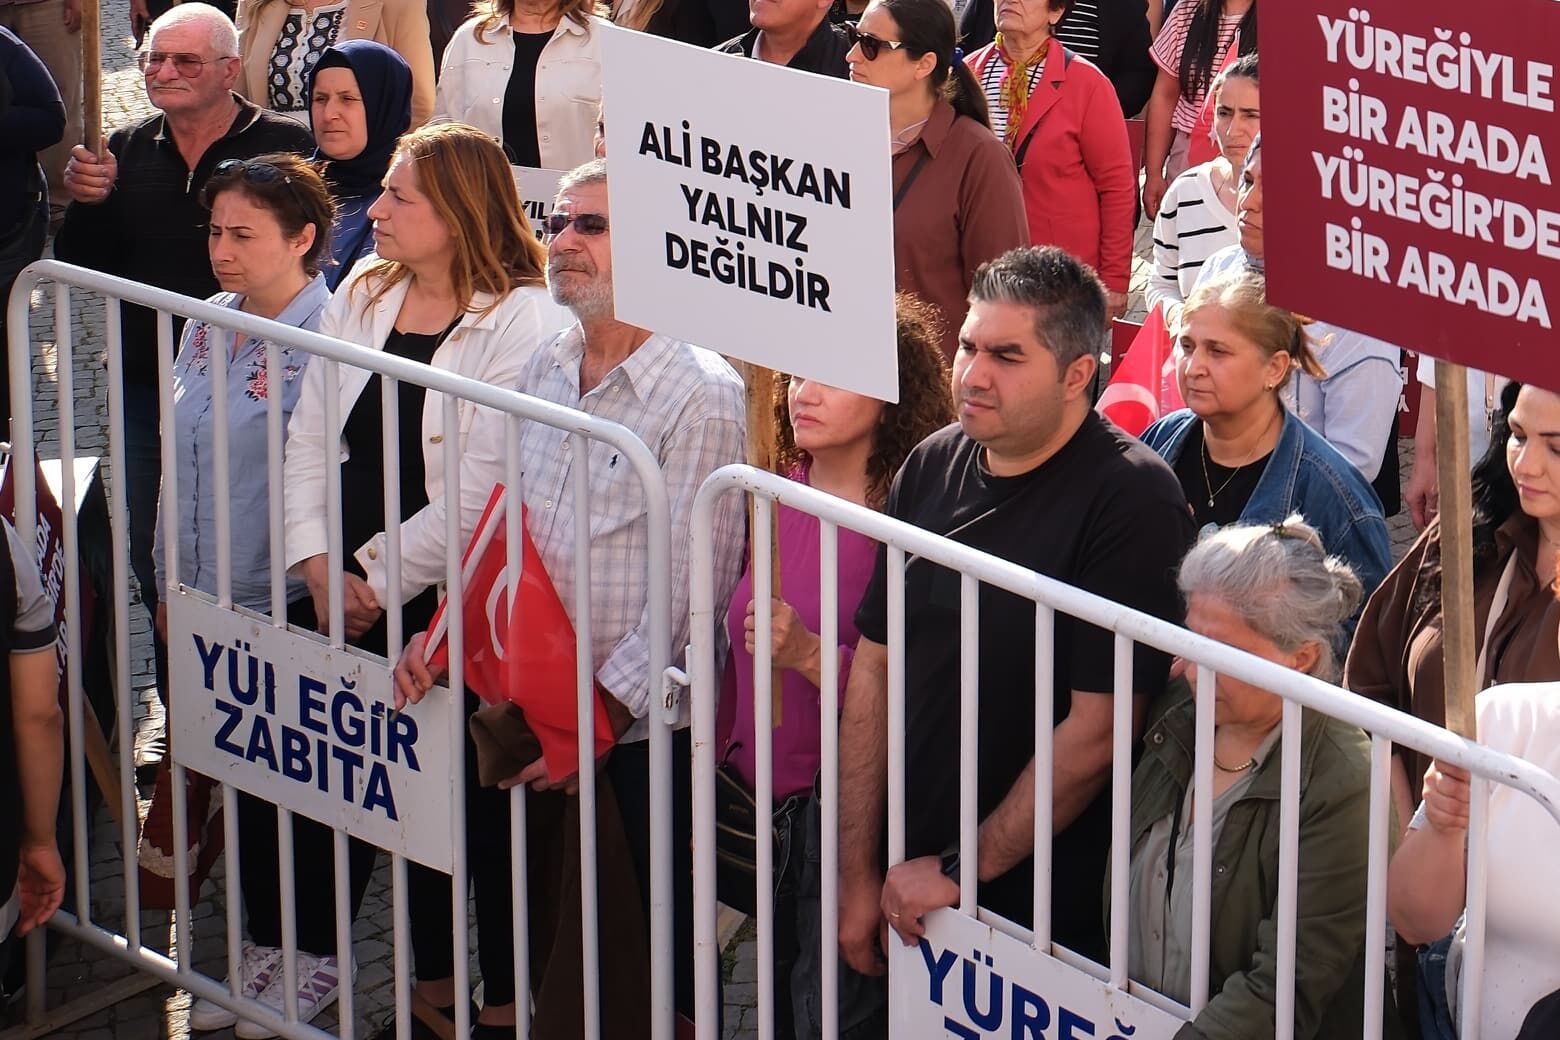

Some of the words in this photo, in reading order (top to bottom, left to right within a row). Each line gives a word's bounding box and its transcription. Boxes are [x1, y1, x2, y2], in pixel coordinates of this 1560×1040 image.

[1316, 7, 1555, 113] YÜREĞİYLE
[638, 119, 693, 169] ALİ
[701, 136, 851, 210] BAŞKAN
[1322, 78, 1389, 146] BİR
[1395, 105, 1552, 186] ARADA
[680, 183, 809, 253] YALNIZ
[665, 231, 832, 313] DEĞİLDİR
[1325, 216, 1391, 285] BİR
[1397, 245, 1553, 329] ARADA
[214, 697, 399, 822] ZABITA
